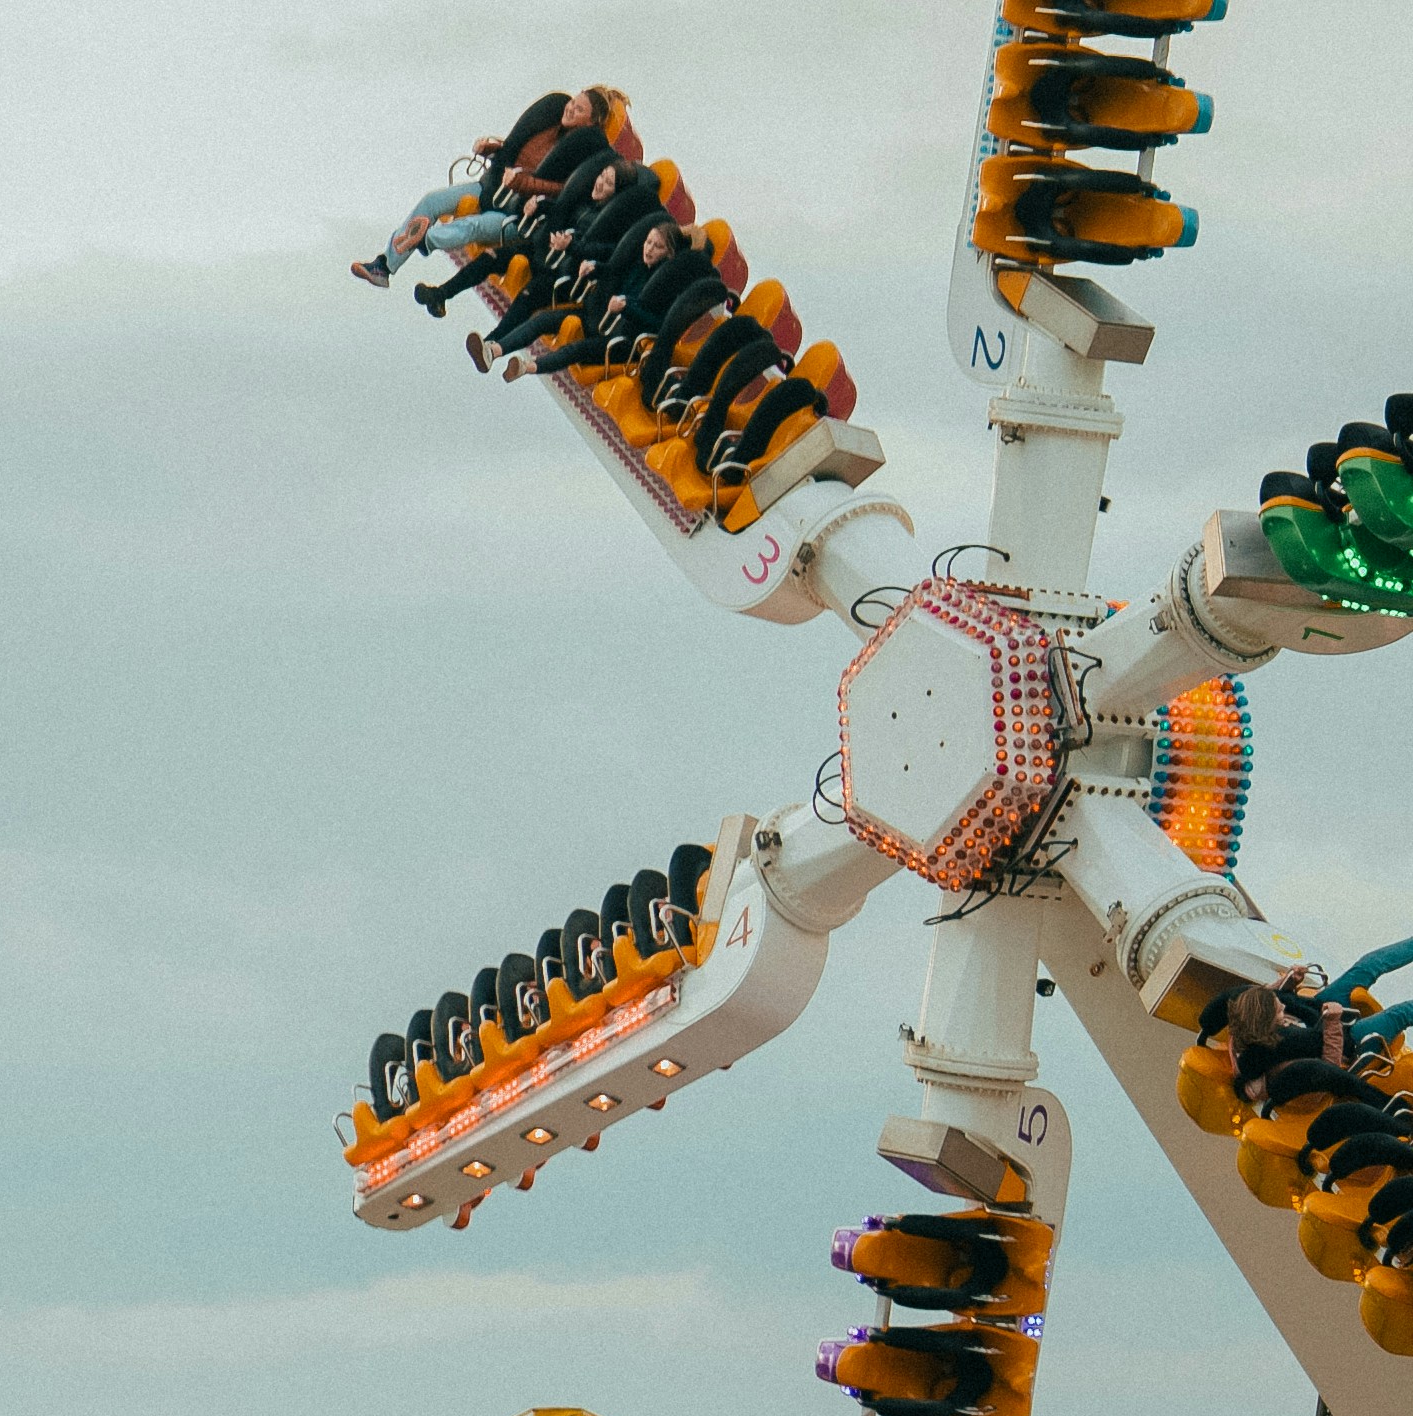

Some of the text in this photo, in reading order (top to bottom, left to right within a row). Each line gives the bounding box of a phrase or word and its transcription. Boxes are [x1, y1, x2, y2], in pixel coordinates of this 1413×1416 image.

[971, 325, 1006, 370] 2
[741, 533, 781, 585] 3
[725, 905, 754, 949] 4
[1017, 1103, 1049, 1147] 5
